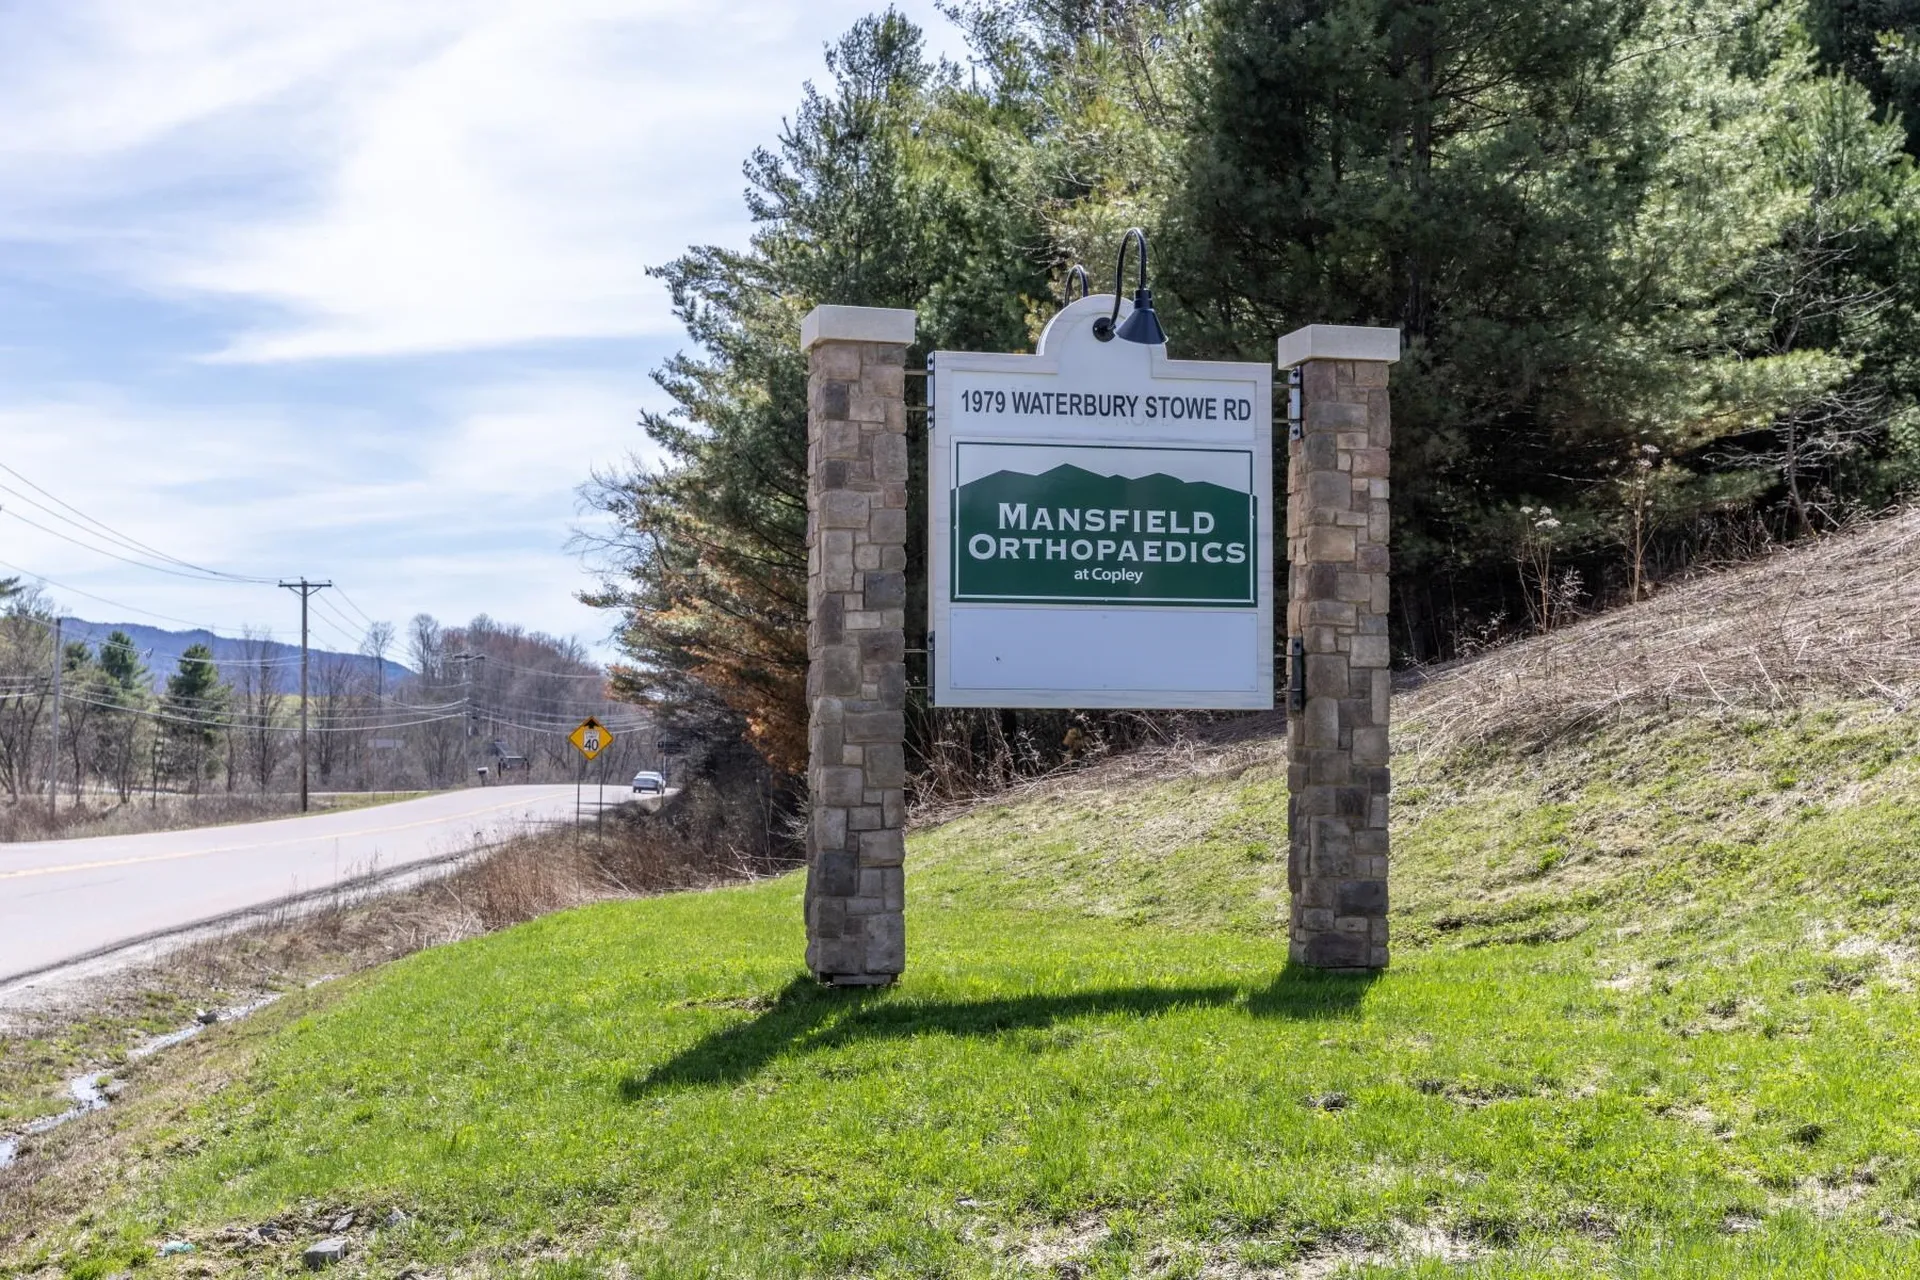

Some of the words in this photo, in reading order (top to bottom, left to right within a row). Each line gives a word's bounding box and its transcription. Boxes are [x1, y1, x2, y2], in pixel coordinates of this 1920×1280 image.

[961, 389, 1006, 413] 1979
[1012, 391, 1138, 417] WATERBURY
[1145, 396, 1218, 420] STOWE
[1224, 398, 1251, 421] RD
[998, 503, 1215, 534] MANSFIELD
[968, 533, 1246, 564] ORTHOPAEDICS
[1073, 570, 1089, 581] at
[1092, 568, 1143, 584] Copley
[584, 739, 599, 751] 40
